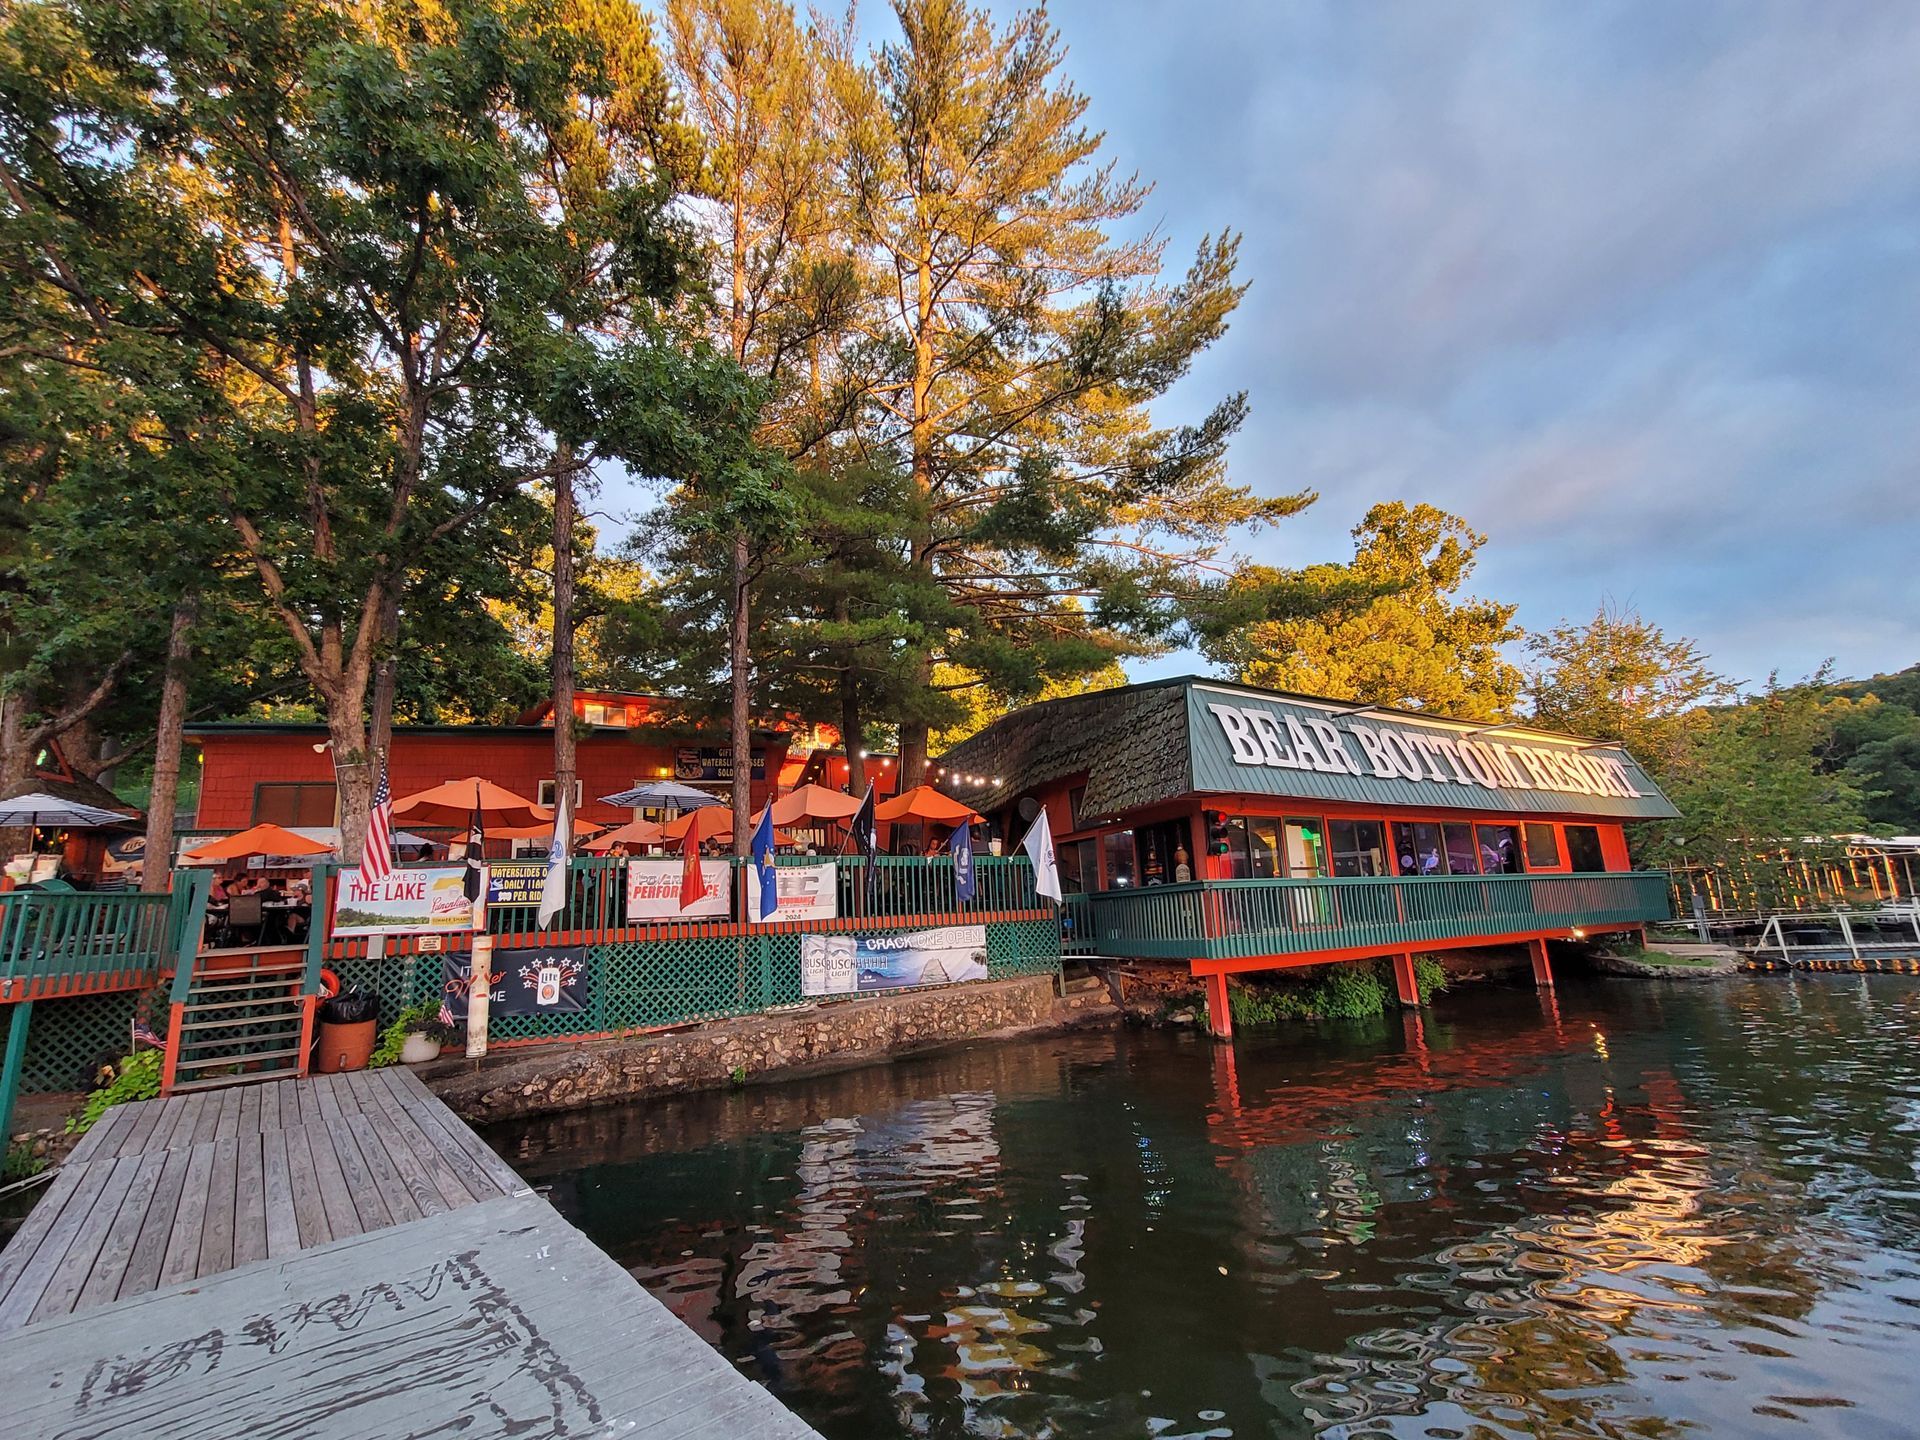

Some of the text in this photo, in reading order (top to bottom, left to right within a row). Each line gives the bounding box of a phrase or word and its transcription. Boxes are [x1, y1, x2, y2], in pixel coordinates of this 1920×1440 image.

[1208, 703, 1641, 798] BEAR BOTTOM RESORT
[702, 758, 733, 767] WATERSLI
[717, 768, 734, 777] SOLD
[124, 840, 145, 851] Lite
[351, 873, 427, 882] WOME TO
[491, 867, 540, 878] WATERSLIDES
[504, 879, 526, 889] DAILY
[349, 882, 427, 902] THE LAKE
[513, 890, 528, 901] PER
[529, 890, 542, 901] RID
[633, 884, 720, 899] PERFORCE
[866, 936, 913, 951] CRACK
[917, 932, 943, 947] ONE
[805, 958, 825, 969] BUSC
[541, 973, 558, 984] Lite
